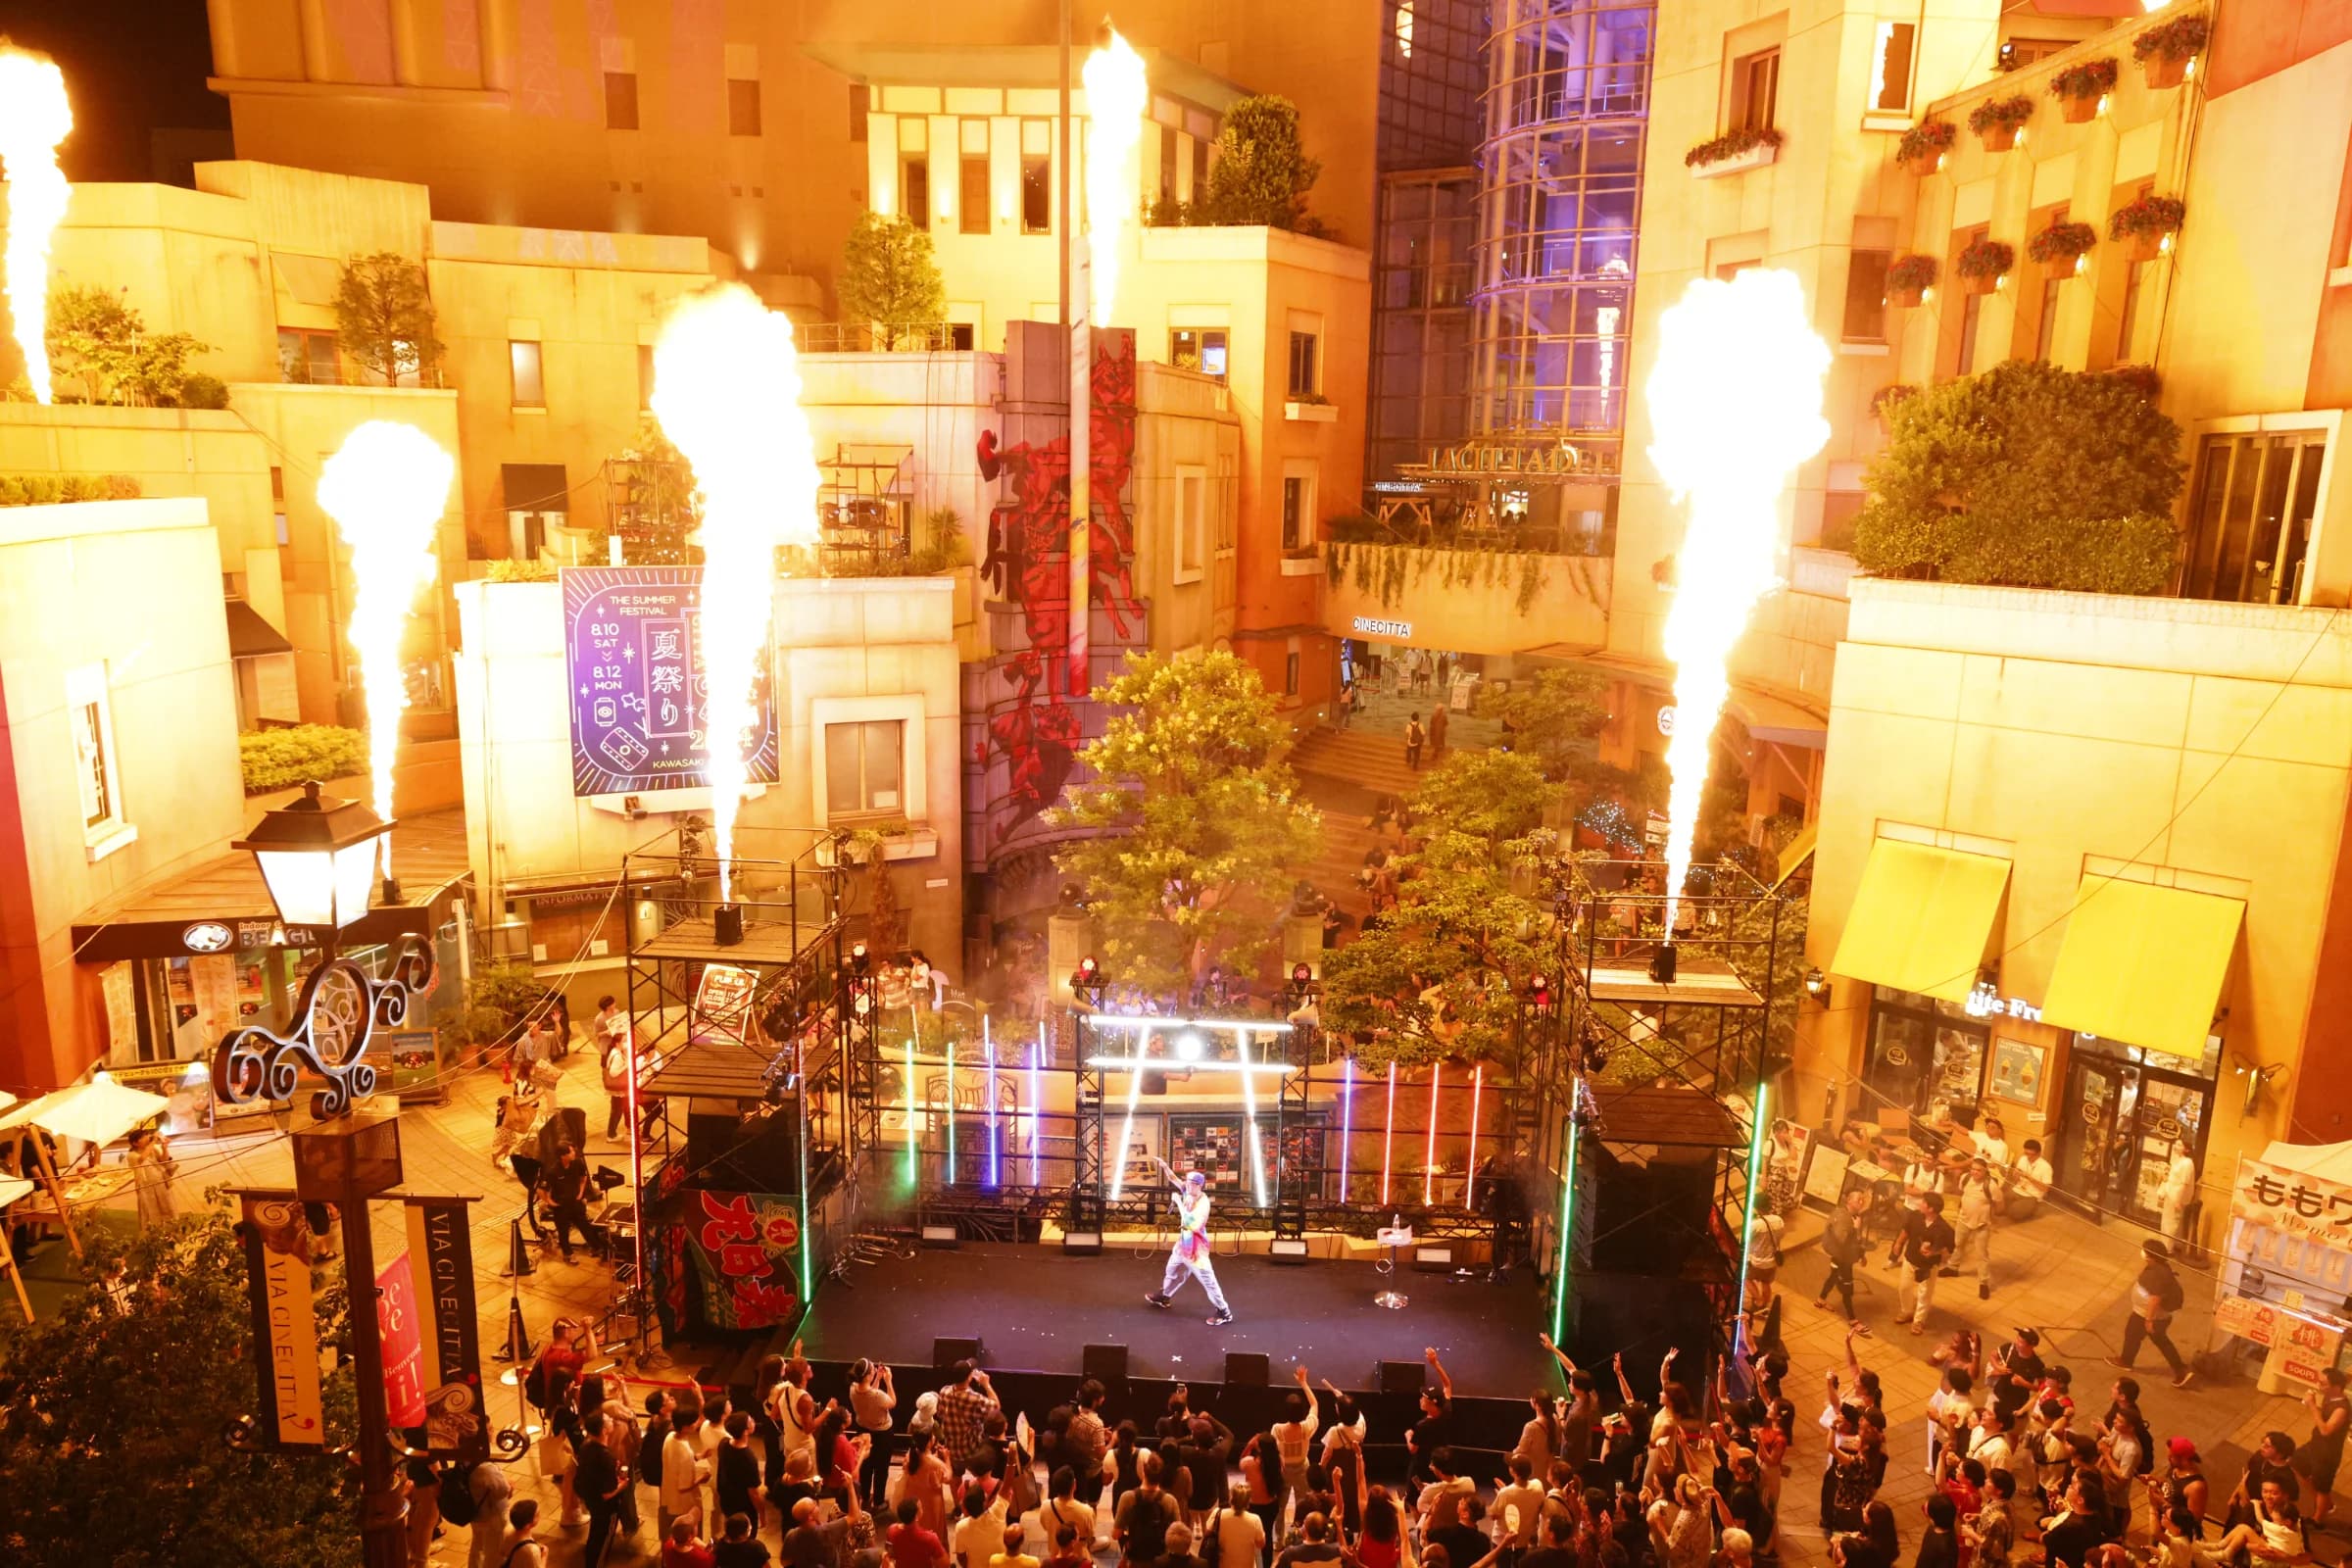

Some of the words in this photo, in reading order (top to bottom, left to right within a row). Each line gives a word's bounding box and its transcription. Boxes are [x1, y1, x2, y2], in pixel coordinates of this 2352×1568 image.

[609, 596, 630, 605] THE
[632, 595, 676, 605] SUMMER
[619, 607, 667, 615] FESTIVAL
[591, 622, 619, 636] 8.10
[594, 639, 618, 648] SAT
[593, 665, 622, 678] 8.12
[651, 628, 684, 727] 夏祭り
[595, 681, 622, 690] MON
[535, 890, 622, 907] INFORMATION
[238, 921, 271, 931] Indoor
[431, 1212, 452, 1251] VIA
[269, 1260, 288, 1298] VIA
